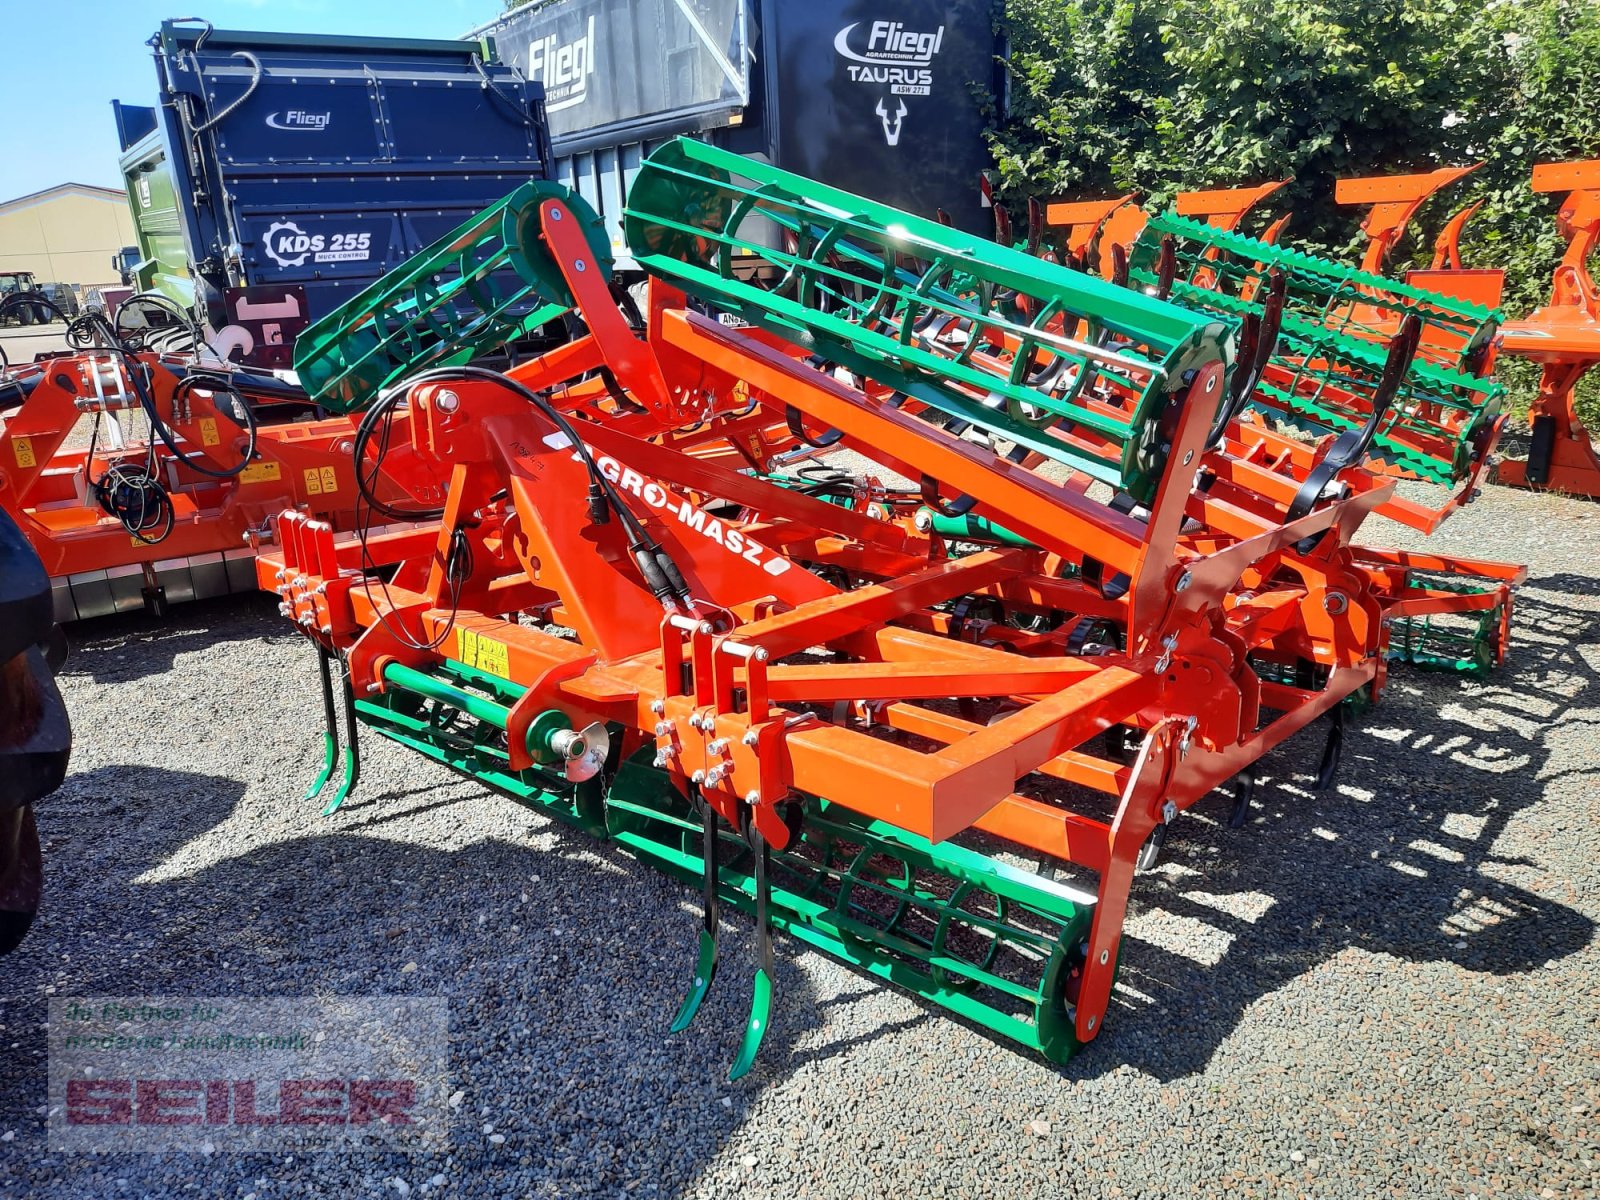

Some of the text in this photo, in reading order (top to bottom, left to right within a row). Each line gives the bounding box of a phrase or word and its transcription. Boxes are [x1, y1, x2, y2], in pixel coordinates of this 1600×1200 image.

[867, 20, 945, 61] Fliegl
[528, 15, 595, 95] Fliegl
[865, 51, 914, 60] AGRARTECHNIK
[847, 65, 933, 85] TAURUS
[545, 87, 571, 103] TECHNIK
[896, 86, 925, 94] ASW 271
[285, 110, 331, 128] Fliegl
[278, 232, 372, 254] KDS 255
[338, 251, 368, 259] CONTROL
[571, 443, 765, 567] AGRO-MASZ
